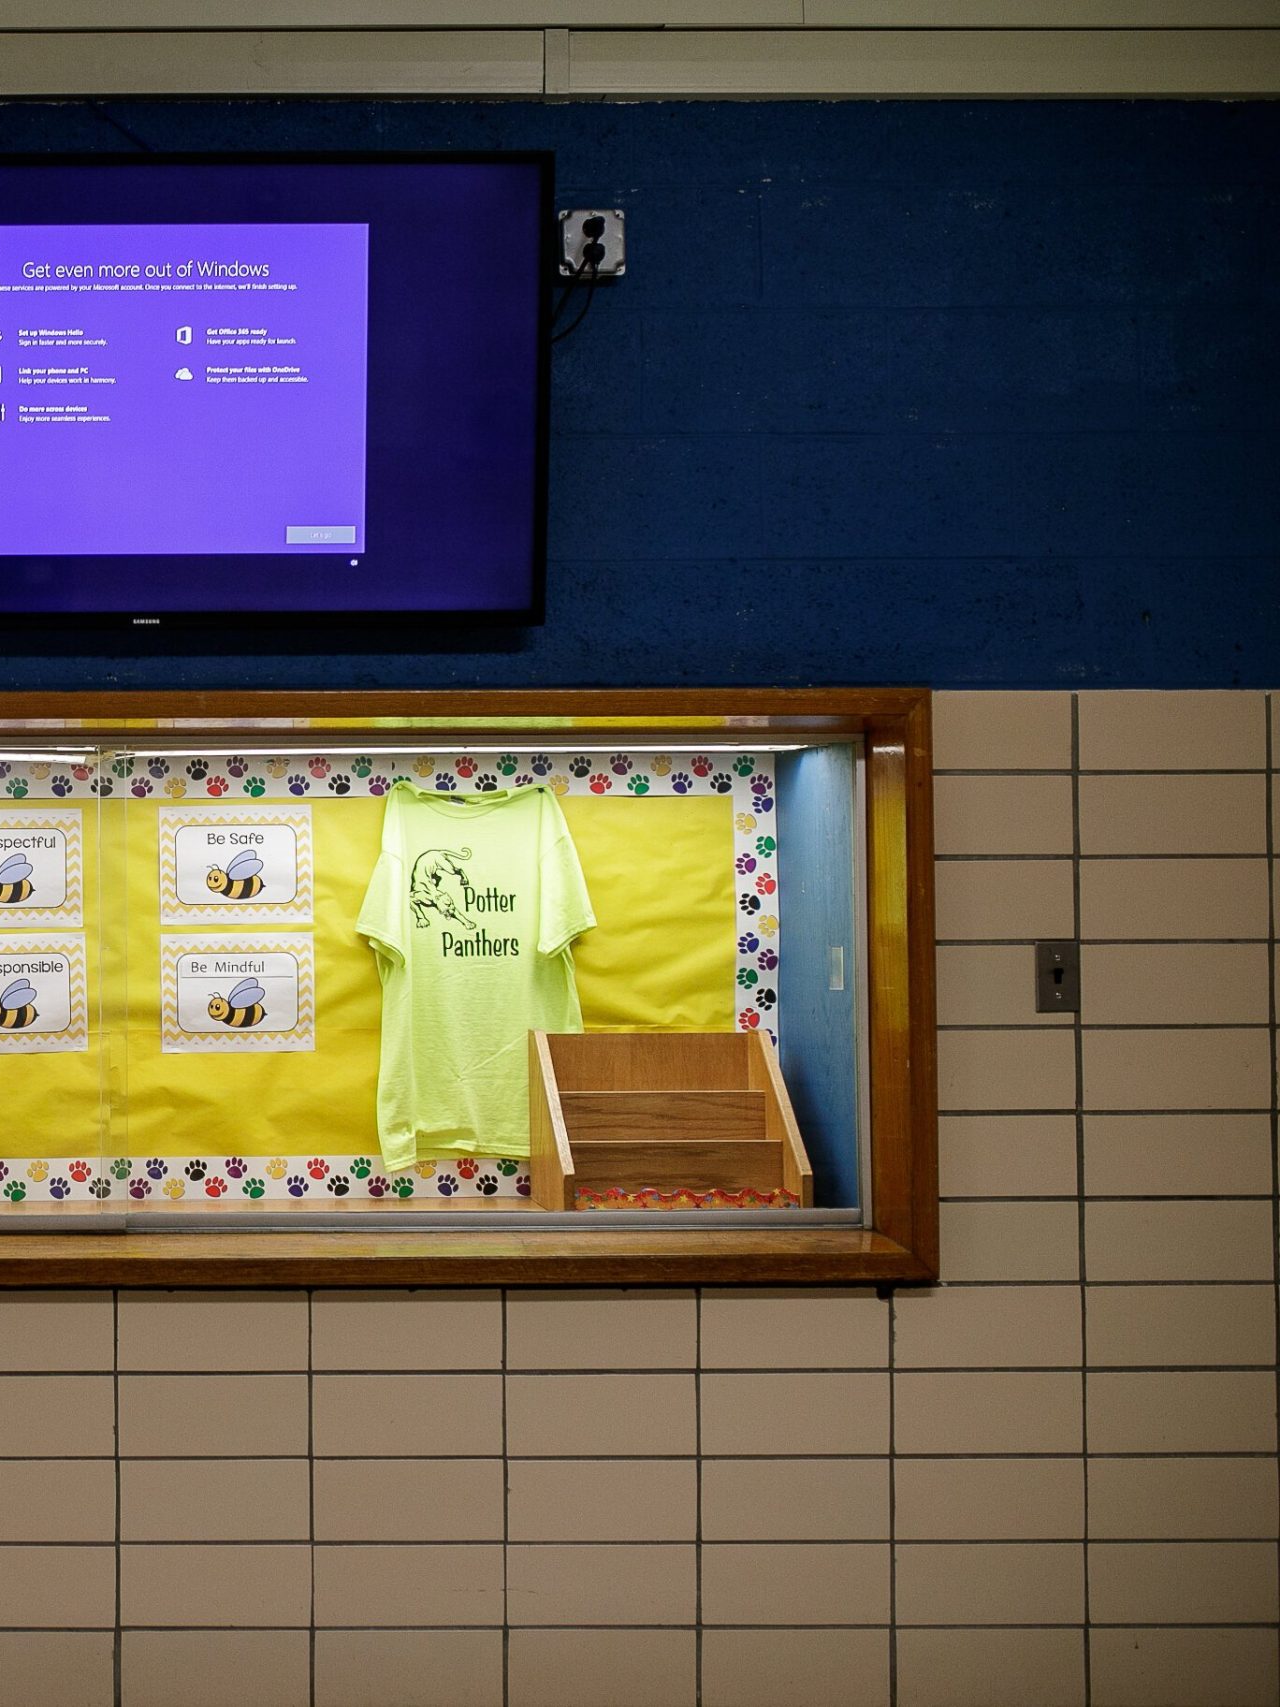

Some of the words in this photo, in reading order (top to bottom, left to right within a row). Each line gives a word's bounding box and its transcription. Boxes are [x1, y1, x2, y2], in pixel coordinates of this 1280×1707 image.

[22, 261, 51, 278] Get
[55, 264, 94, 278] even
[98, 264, 140, 278] more
[144, 263, 172, 277] out
[176, 260, 194, 277] of
[196, 260, 270, 277] Windows
[12, 284, 34, 292] services
[45, 284, 69, 292] powered
[70, 284, 78, 292] by
[79, 285, 92, 293] your
[93, 284, 119, 292] Microsoft
[120, 284, 144, 292] account.
[145, 284, 160, 292] Once
[161, 285, 172, 293] you
[173, 284, 195, 292] connect
[203, 284, 212, 292] the
[252, 283, 267, 291] finish
[268, 284, 287, 292] setting
[30, 330, 37, 338] up
[250, 329, 267, 337] ready
[84, 339, 107, 347] securely.
[251, 338, 266, 346] ready
[48, 368, 66, 376] phone
[90, 377, 116, 385] harmony.
[207, 377, 221, 385] Keep
[19, 416, 34, 424] Enjoy
[207, 832, 225, 845] Be
[229, 832, 264, 845] Safe
[465, 886, 517, 913] Potter
[442, 932, 519, 958] Panthers
[191, 961, 207, 973] Be
[214, 960, 265, 973] Mindful
